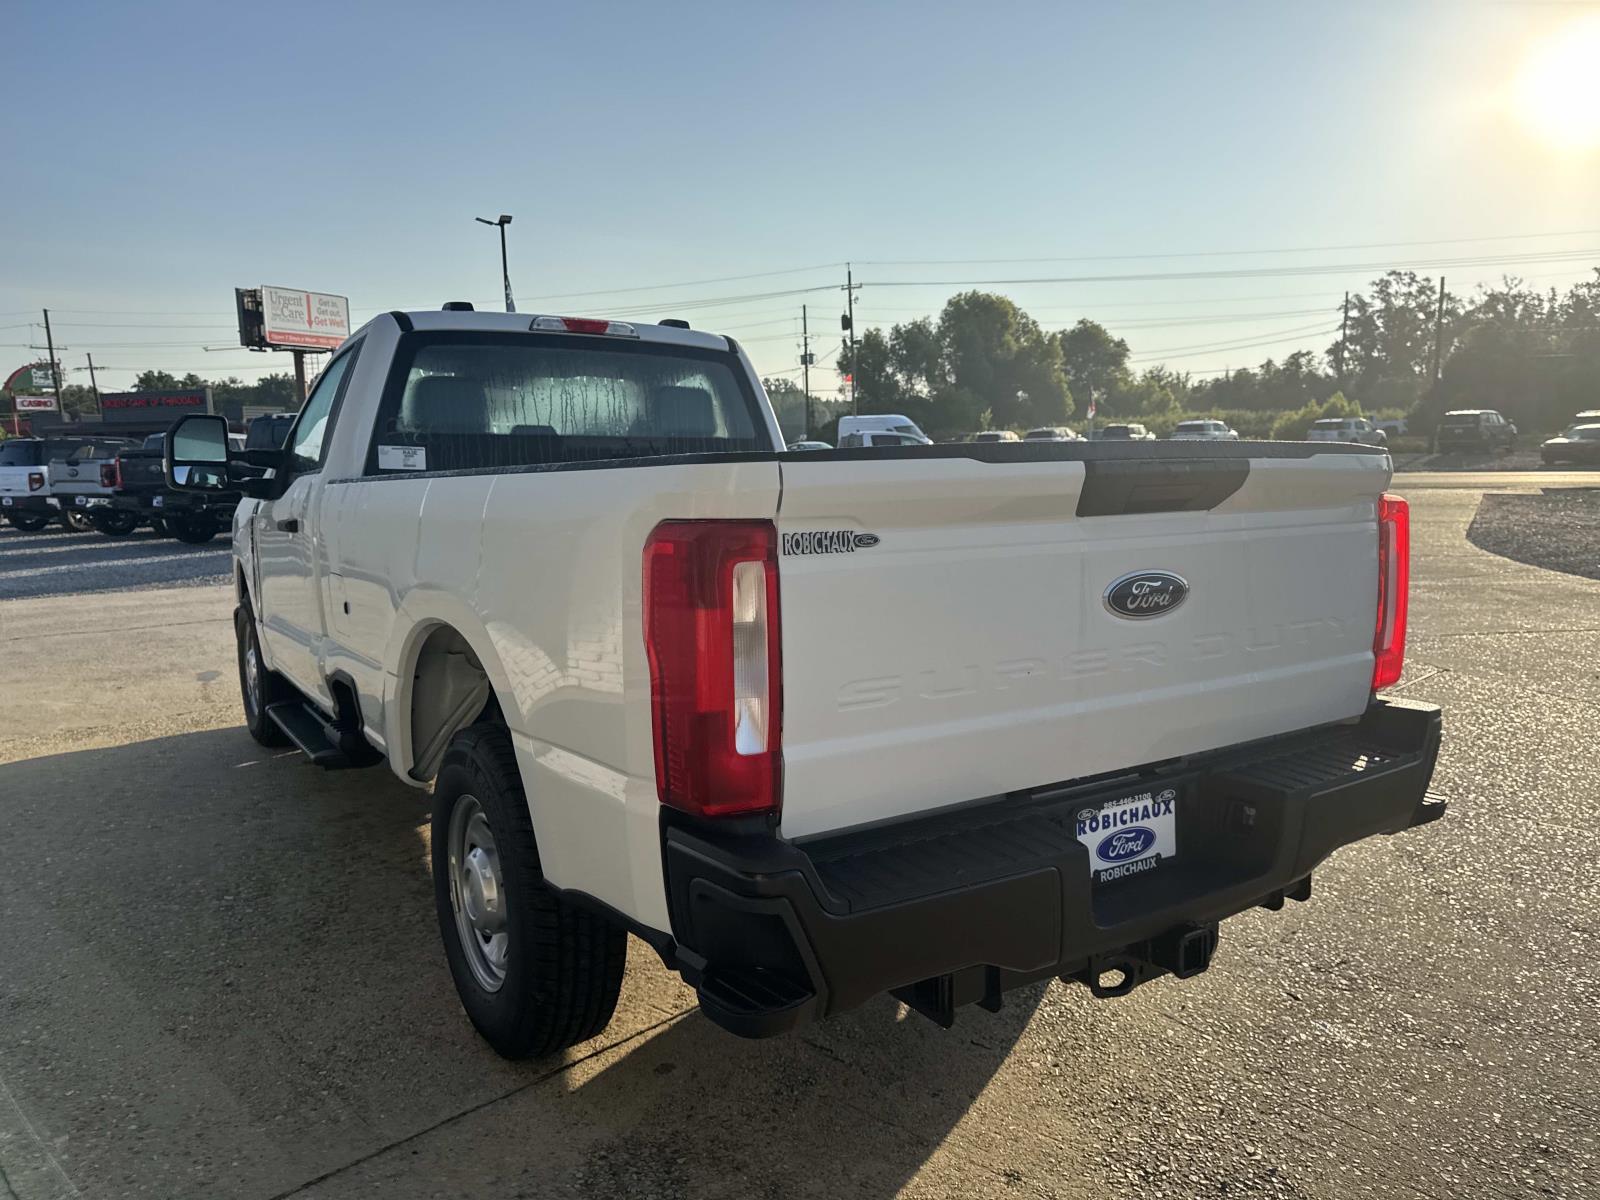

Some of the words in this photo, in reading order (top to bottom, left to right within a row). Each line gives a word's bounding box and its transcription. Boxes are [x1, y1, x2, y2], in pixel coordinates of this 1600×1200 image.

[270, 291, 303, 309] Urgent
[318, 298, 330, 307] Get
[281, 303, 304, 320] Care
[314, 316, 328, 327] Get
[317, 307, 329, 316] Get
[21, 399, 53, 408] CASINO
[783, 531, 855, 555] ROBICHAUX
[1127, 581, 1173, 609] Ford
[836, 639, 1168, 712] SUPER
[1191, 616, 1352, 662] DUTY
[1077, 800, 1173, 836] ROBICHAUX
[1108, 832, 1145, 857] Ford
[1100, 857, 1157, 883] ROBICHAUX
